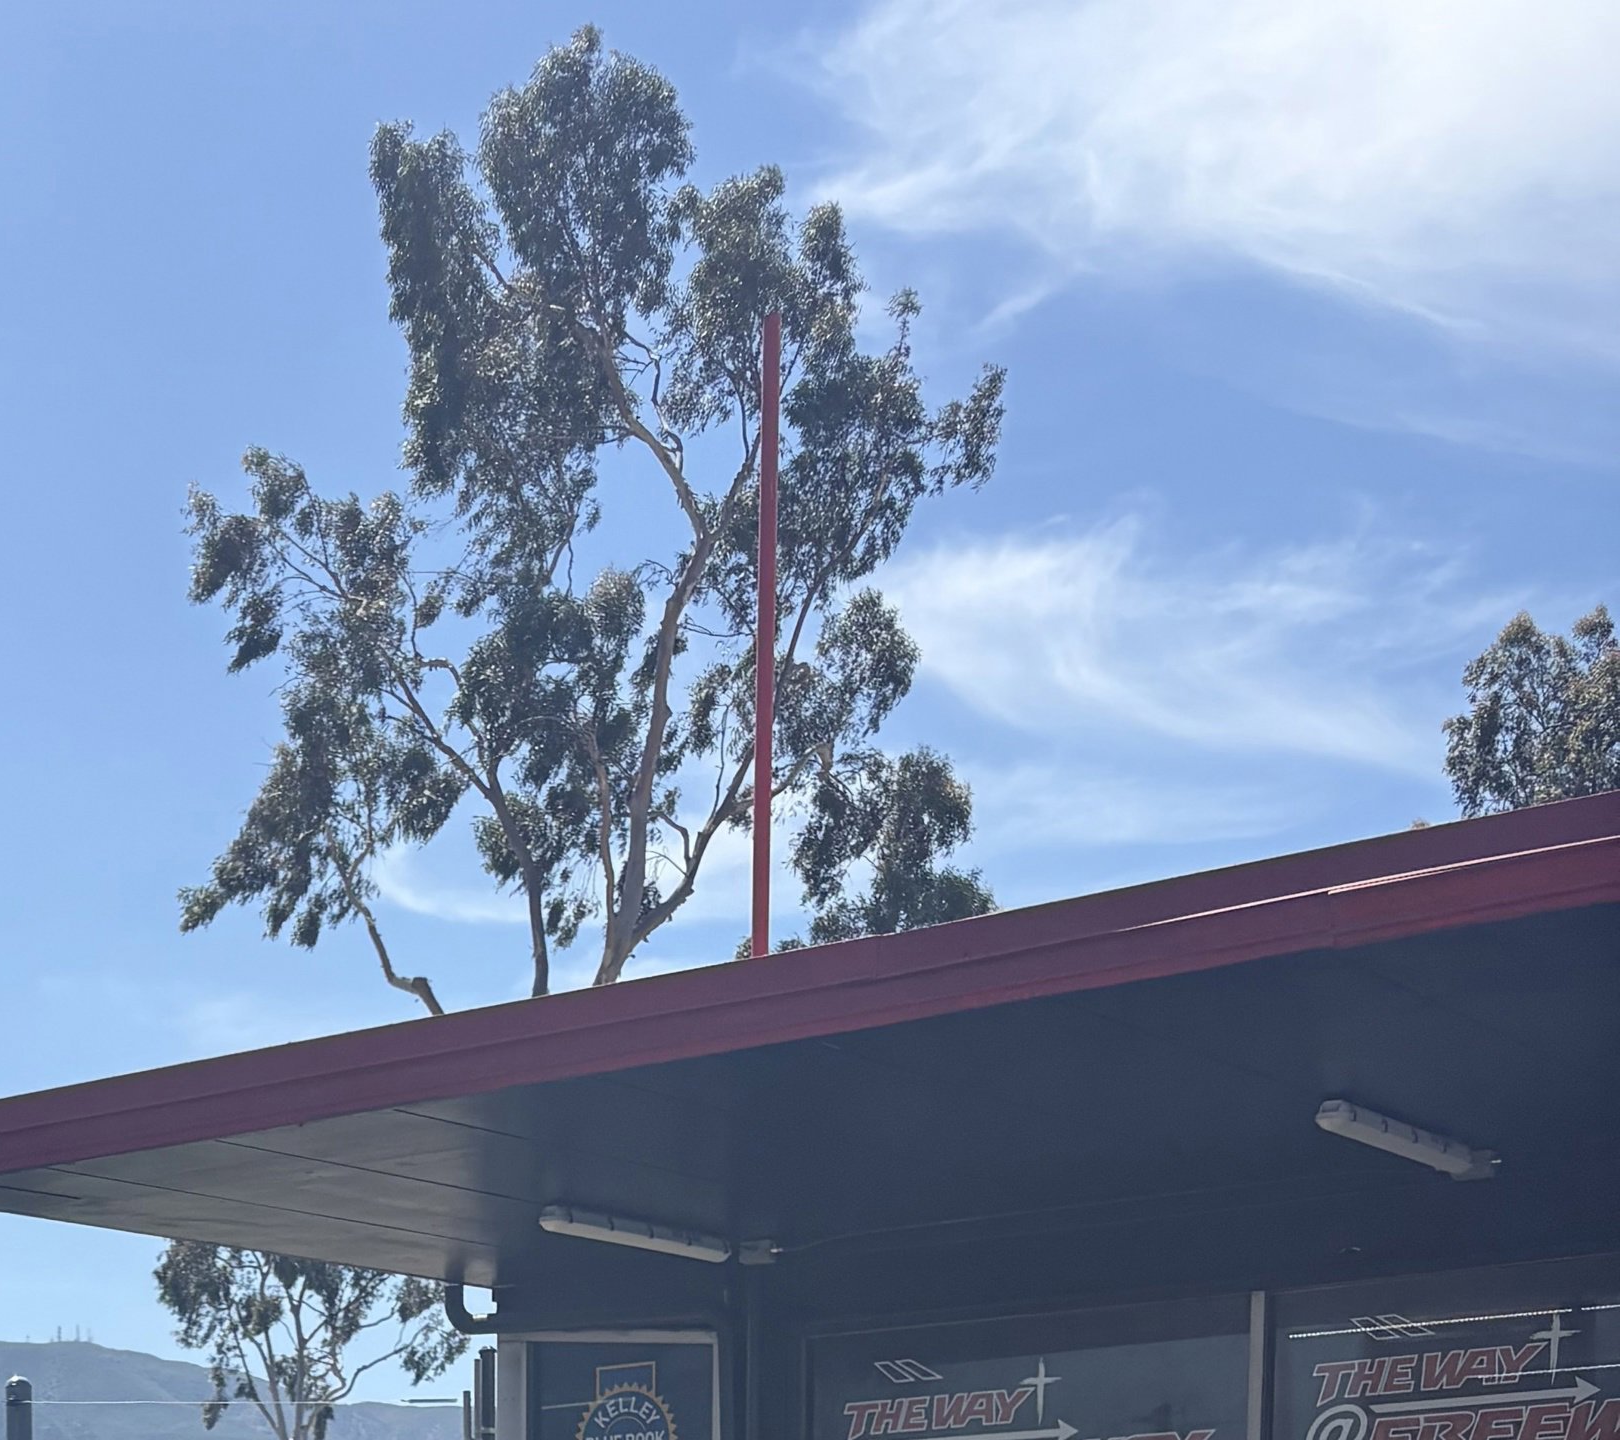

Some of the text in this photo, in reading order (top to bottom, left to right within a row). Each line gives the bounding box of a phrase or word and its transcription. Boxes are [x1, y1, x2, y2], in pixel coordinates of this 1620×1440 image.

[1312, 1341, 1548, 1407] THE WAY
[594, 1396, 660, 1429] KELLEY
[932, 1386, 1037, 1430] WAY
